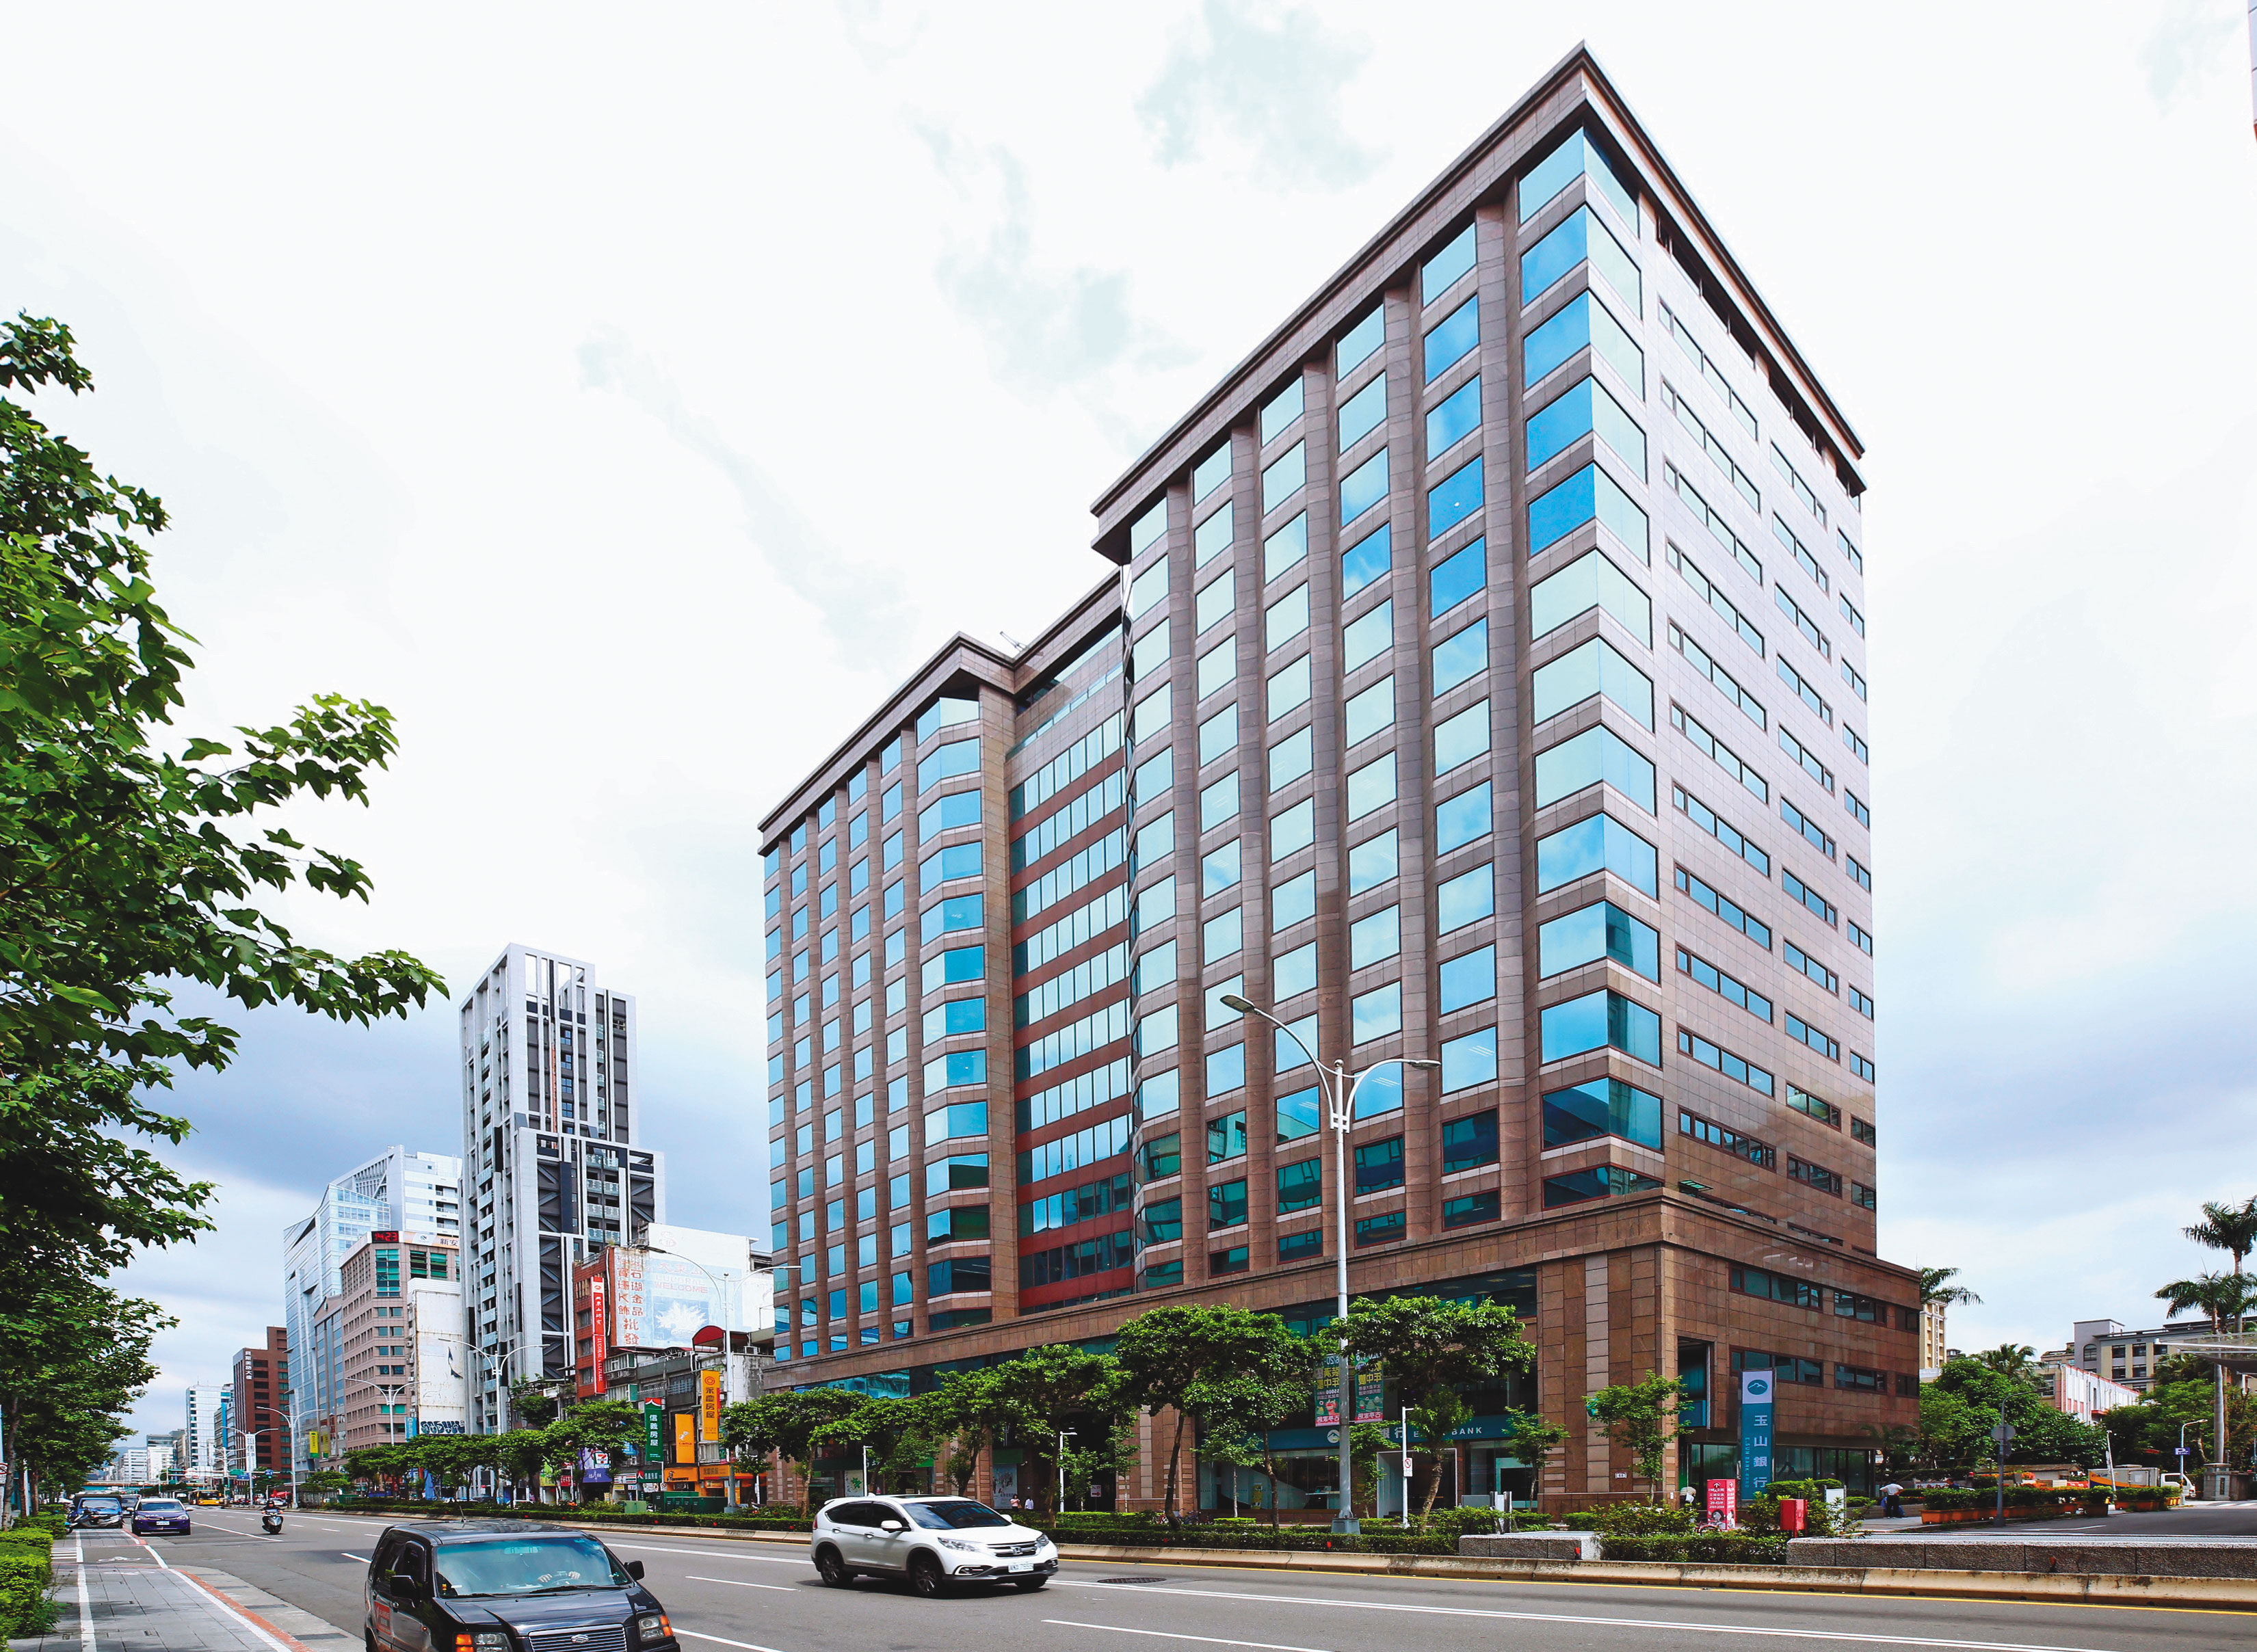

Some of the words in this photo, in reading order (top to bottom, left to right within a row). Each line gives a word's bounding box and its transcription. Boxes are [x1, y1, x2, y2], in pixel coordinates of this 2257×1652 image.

[655, 1281, 709, 1294] WELCOME
[705, 1387, 715, 1418] 永慶房屋
[649, 1415, 659, 1446] 信義房屋
[1451, 1426, 1483, 1435] BANK
[1754, 1415, 1768, 1488] 玉山銀行
